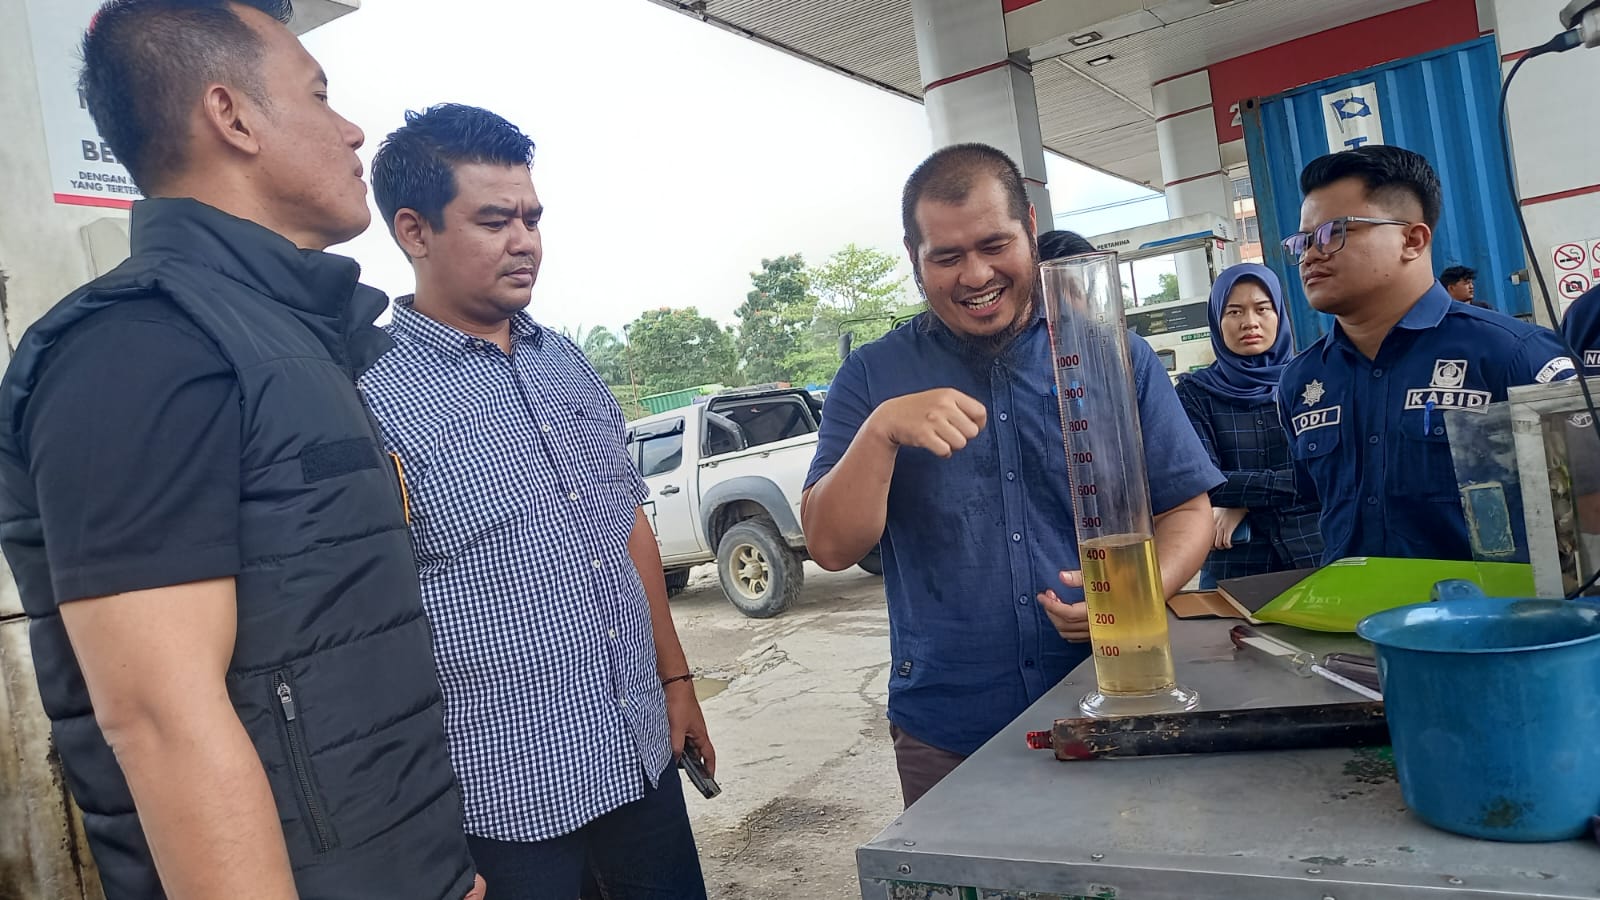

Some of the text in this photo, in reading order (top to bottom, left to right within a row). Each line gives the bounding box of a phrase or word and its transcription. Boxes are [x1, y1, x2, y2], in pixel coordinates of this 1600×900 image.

[79, 171, 127, 184] DENGAN
[70, 180, 103, 191] YANG
[1096, 239, 1130, 250] PERTAMINA
[1057, 355, 1079, 368] 1000
[1064, 387, 1084, 399] 900
[1411, 391, 1482, 407] KABID
[1300, 411, 1327, 428] ODI
[1069, 420, 1088, 432] 800
[1073, 452, 1092, 463] 700
[1078, 485, 1097, 496] 600
[1082, 517, 1102, 528] 500
[1087, 549, 1105, 560] 400
[1091, 581, 1110, 592] 300
[1095, 613, 1115, 625] 200
[1100, 646, 1119, 657] 100
